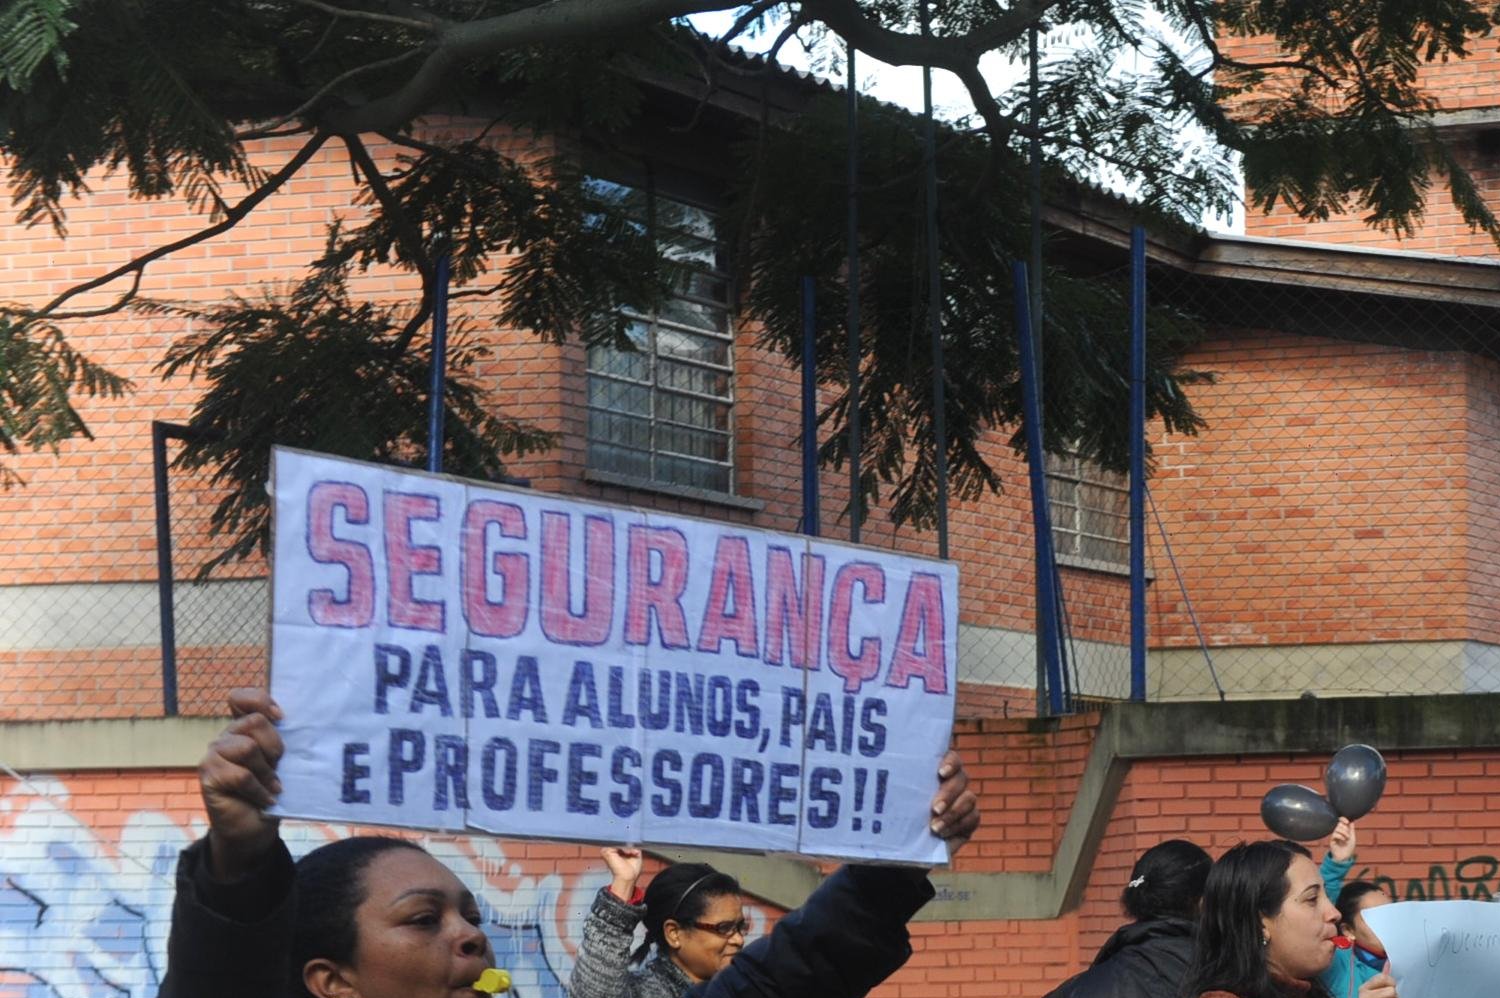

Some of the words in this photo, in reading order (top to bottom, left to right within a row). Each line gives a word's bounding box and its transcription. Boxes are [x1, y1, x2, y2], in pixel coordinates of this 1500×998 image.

[306, 480, 949, 694] SEGURANÇA
[374, 644, 549, 724] PARA
[562, 660, 771, 753] ALUNOS,
[780, 686, 888, 758] PAIS
[342, 742, 371, 804] E
[387, 727, 889, 836] PROFESSORES!!
